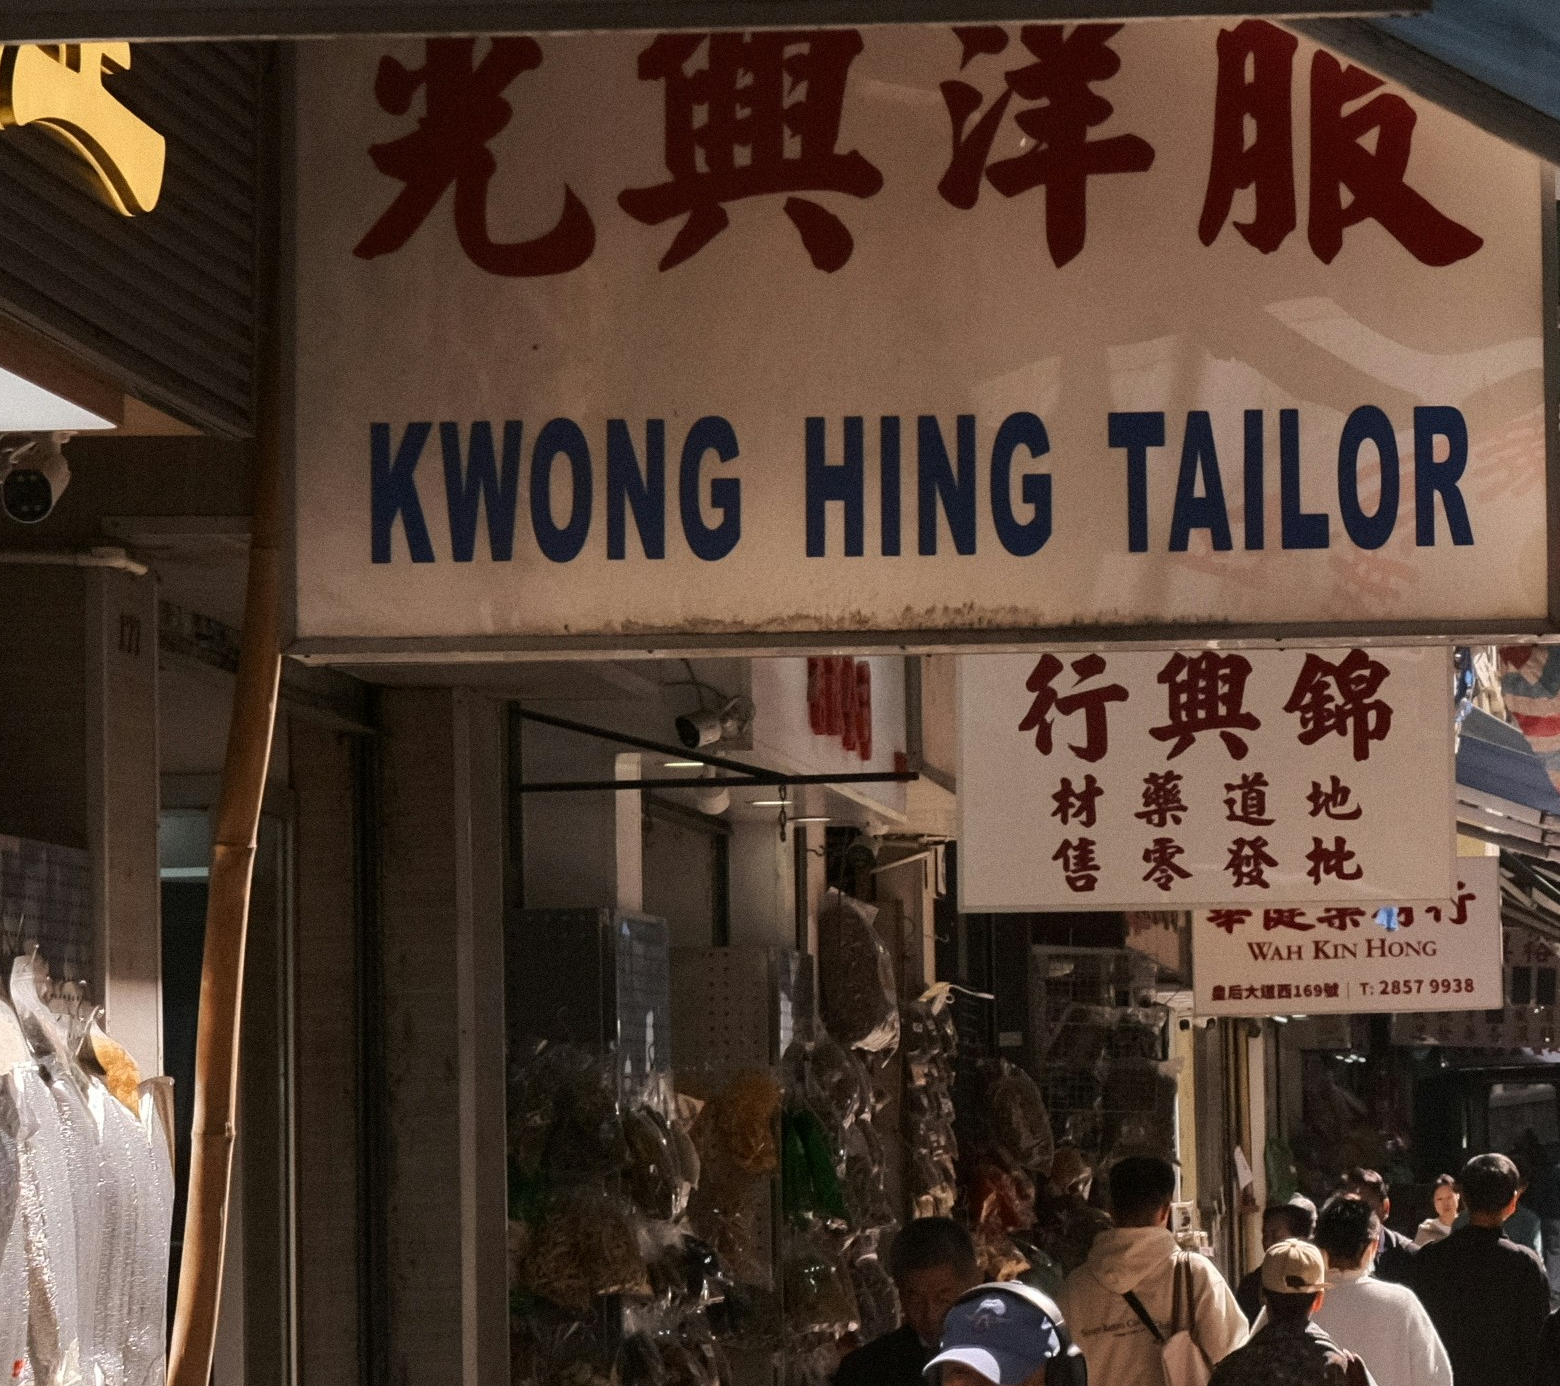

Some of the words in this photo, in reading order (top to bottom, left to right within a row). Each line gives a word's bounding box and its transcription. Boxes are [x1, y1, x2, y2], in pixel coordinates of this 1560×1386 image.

[352, 20, 1484, 279] 光興洋服
[368, 415, 741, 565] KWONG
[804, 411, 1053, 558] HING
[1106, 404, 1475, 554] TAILOR
[1211, 982, 1340, 1001] 皇后大道西169號
[1378, 979, 1423, 995] 2857
[1429, 978, 1475, 994] 9938
[1247, 941, 1304, 962] WAH
[1312, 939, 1357, 960] KIN
[1364, 938, 1438, 959] HONG
